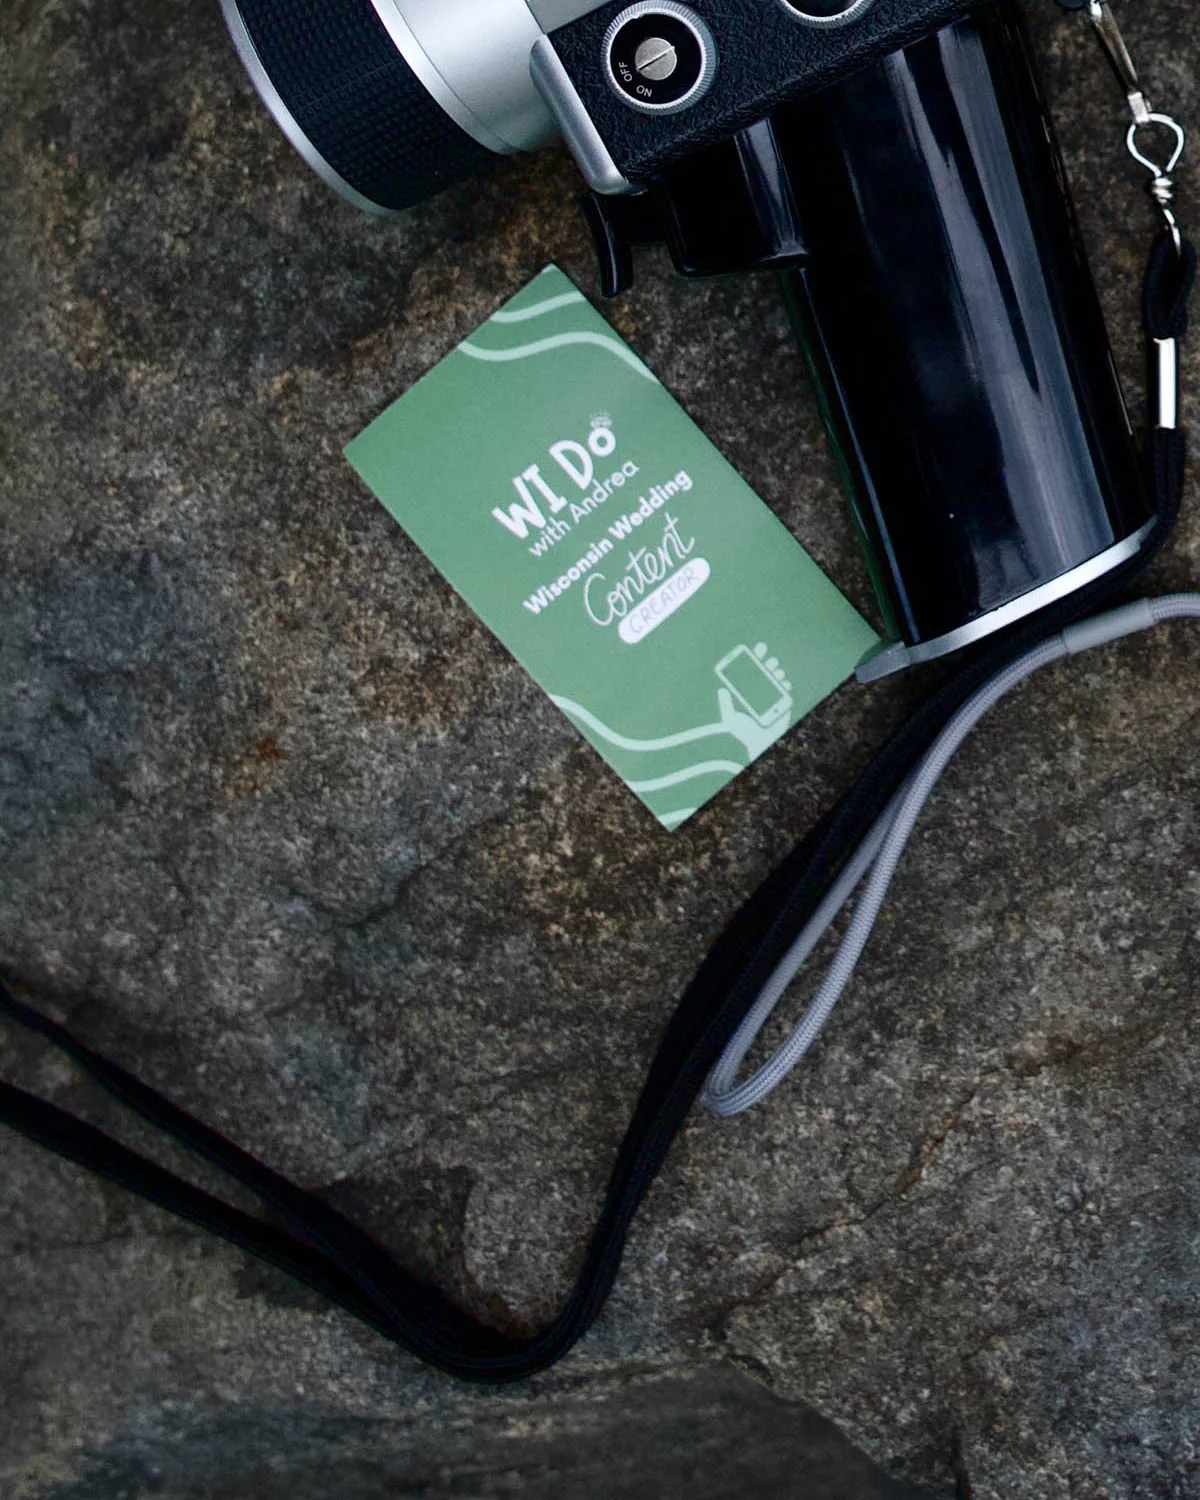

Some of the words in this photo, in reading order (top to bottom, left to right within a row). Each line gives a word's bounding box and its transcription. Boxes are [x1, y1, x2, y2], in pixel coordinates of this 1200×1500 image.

[618, 61, 633, 82] OFF
[636, 85, 653, 98] ON
[491, 463, 568, 540] WI
[529, 516, 571, 557] with
[568, 460, 640, 525] Andrea
[522, 538, 614, 616] Wisconsin
[608, 470, 694, 541] Wedding
[584, 511, 696, 626] Content
[629, 565, 700, 634] CREATOR
